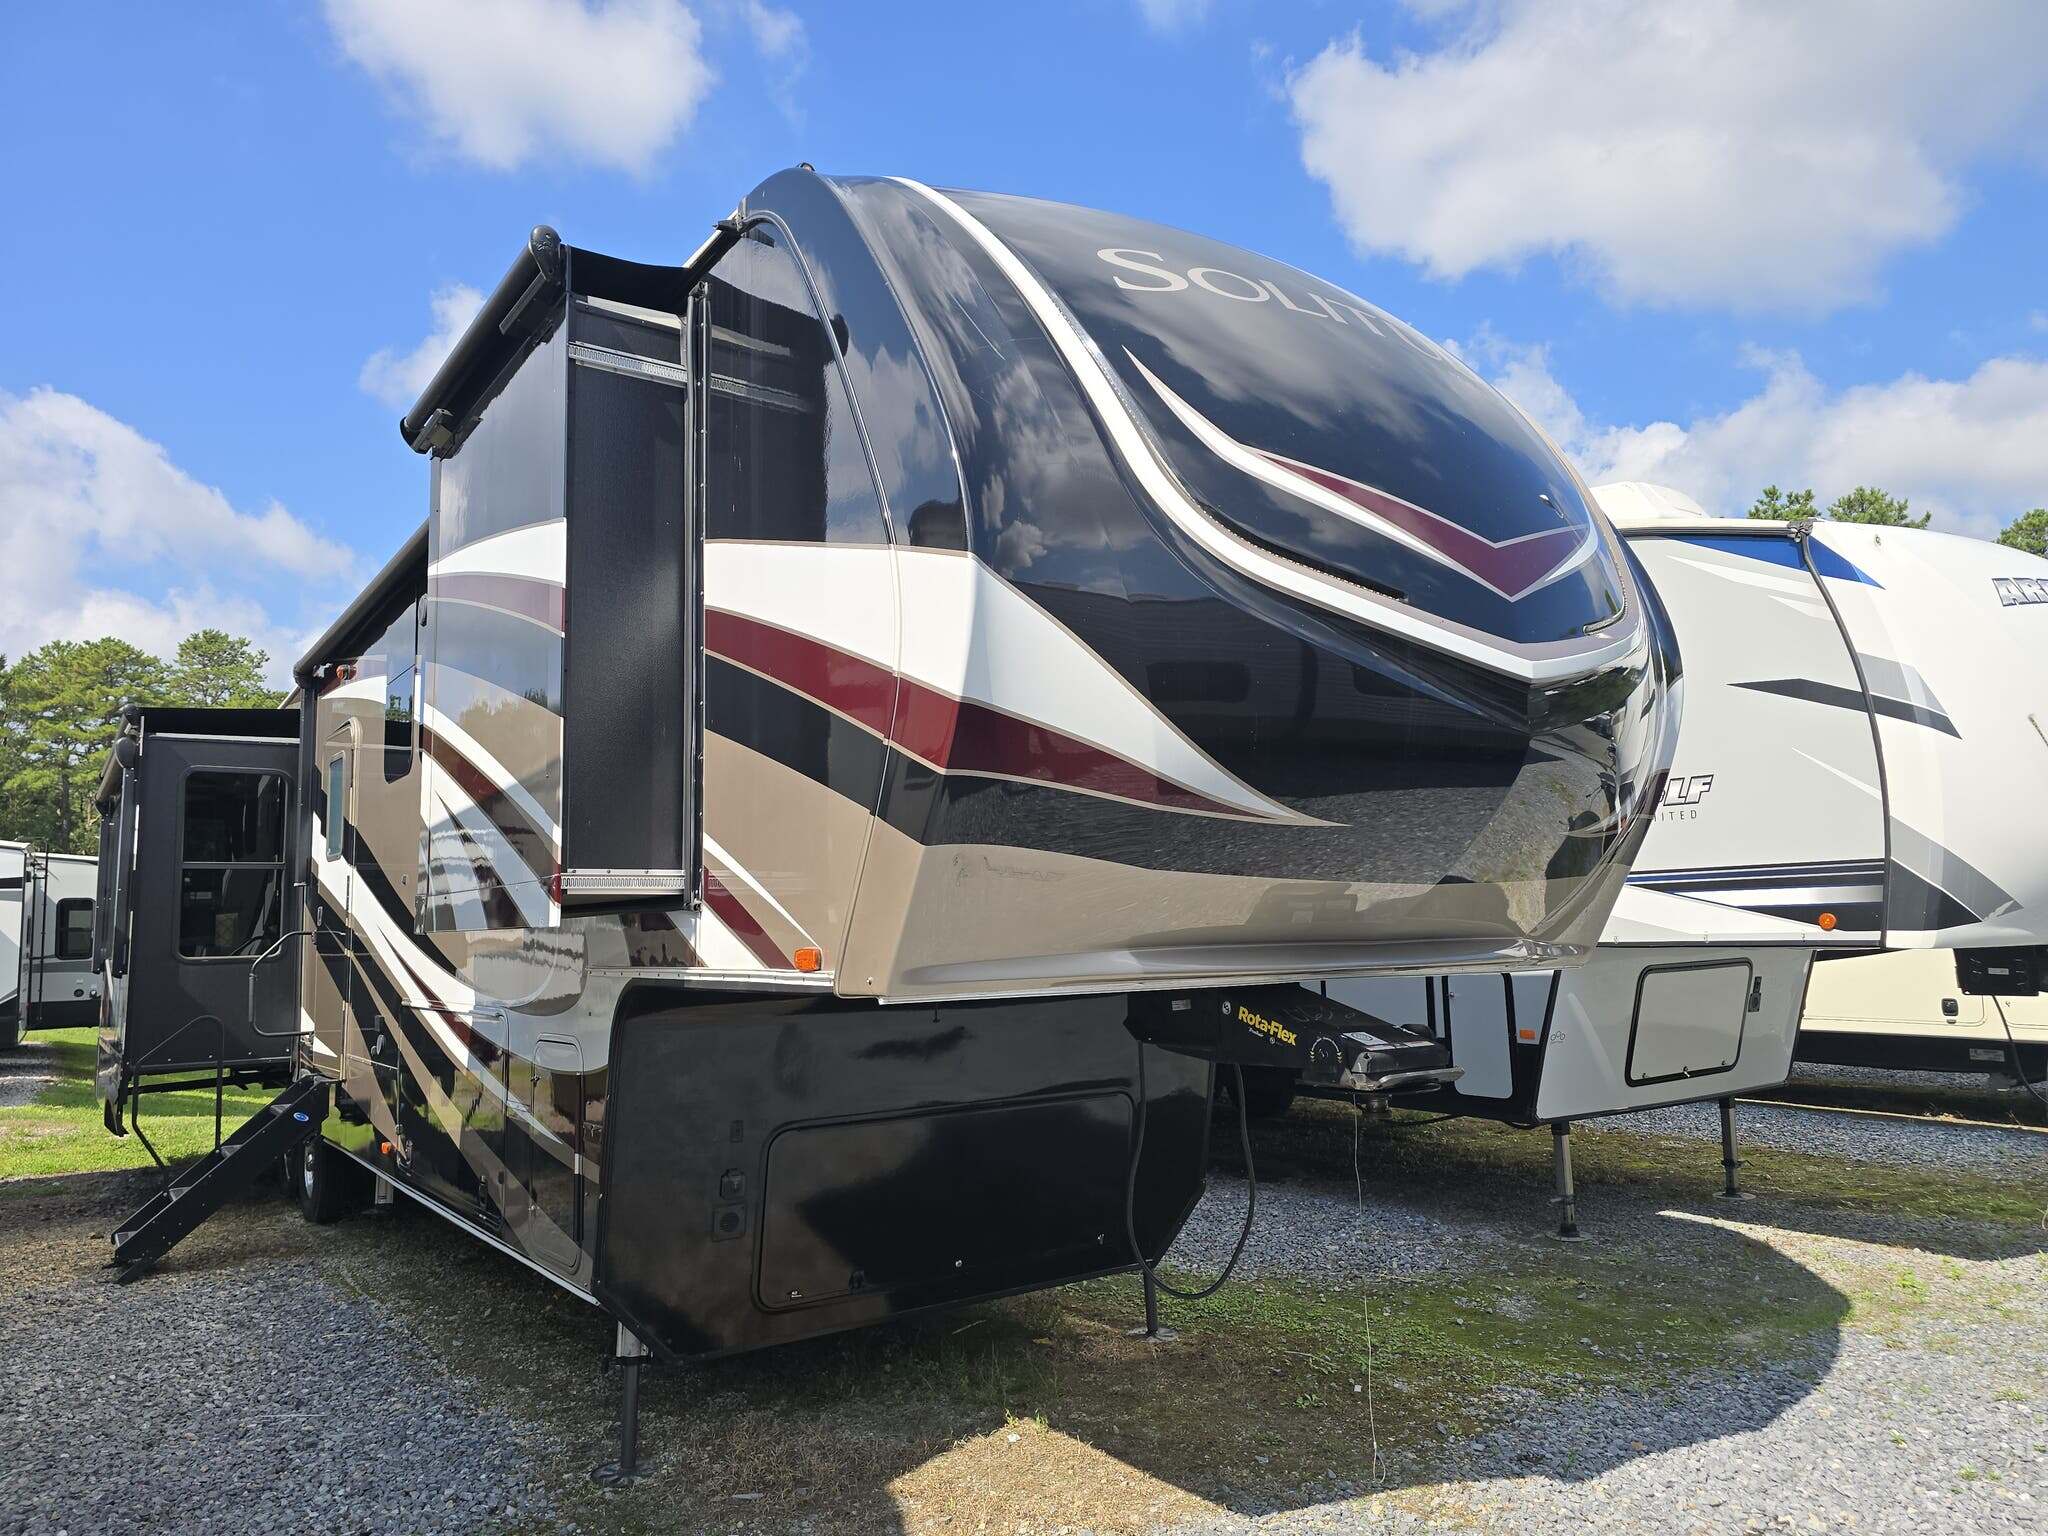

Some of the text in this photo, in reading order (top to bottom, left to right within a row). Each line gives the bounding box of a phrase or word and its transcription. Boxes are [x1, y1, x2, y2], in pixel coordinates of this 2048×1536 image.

[1660, 774, 1714, 807] LF
[1654, 809, 1697, 822] ITED
[1238, 1006, 1298, 1046] Rota-Flex
